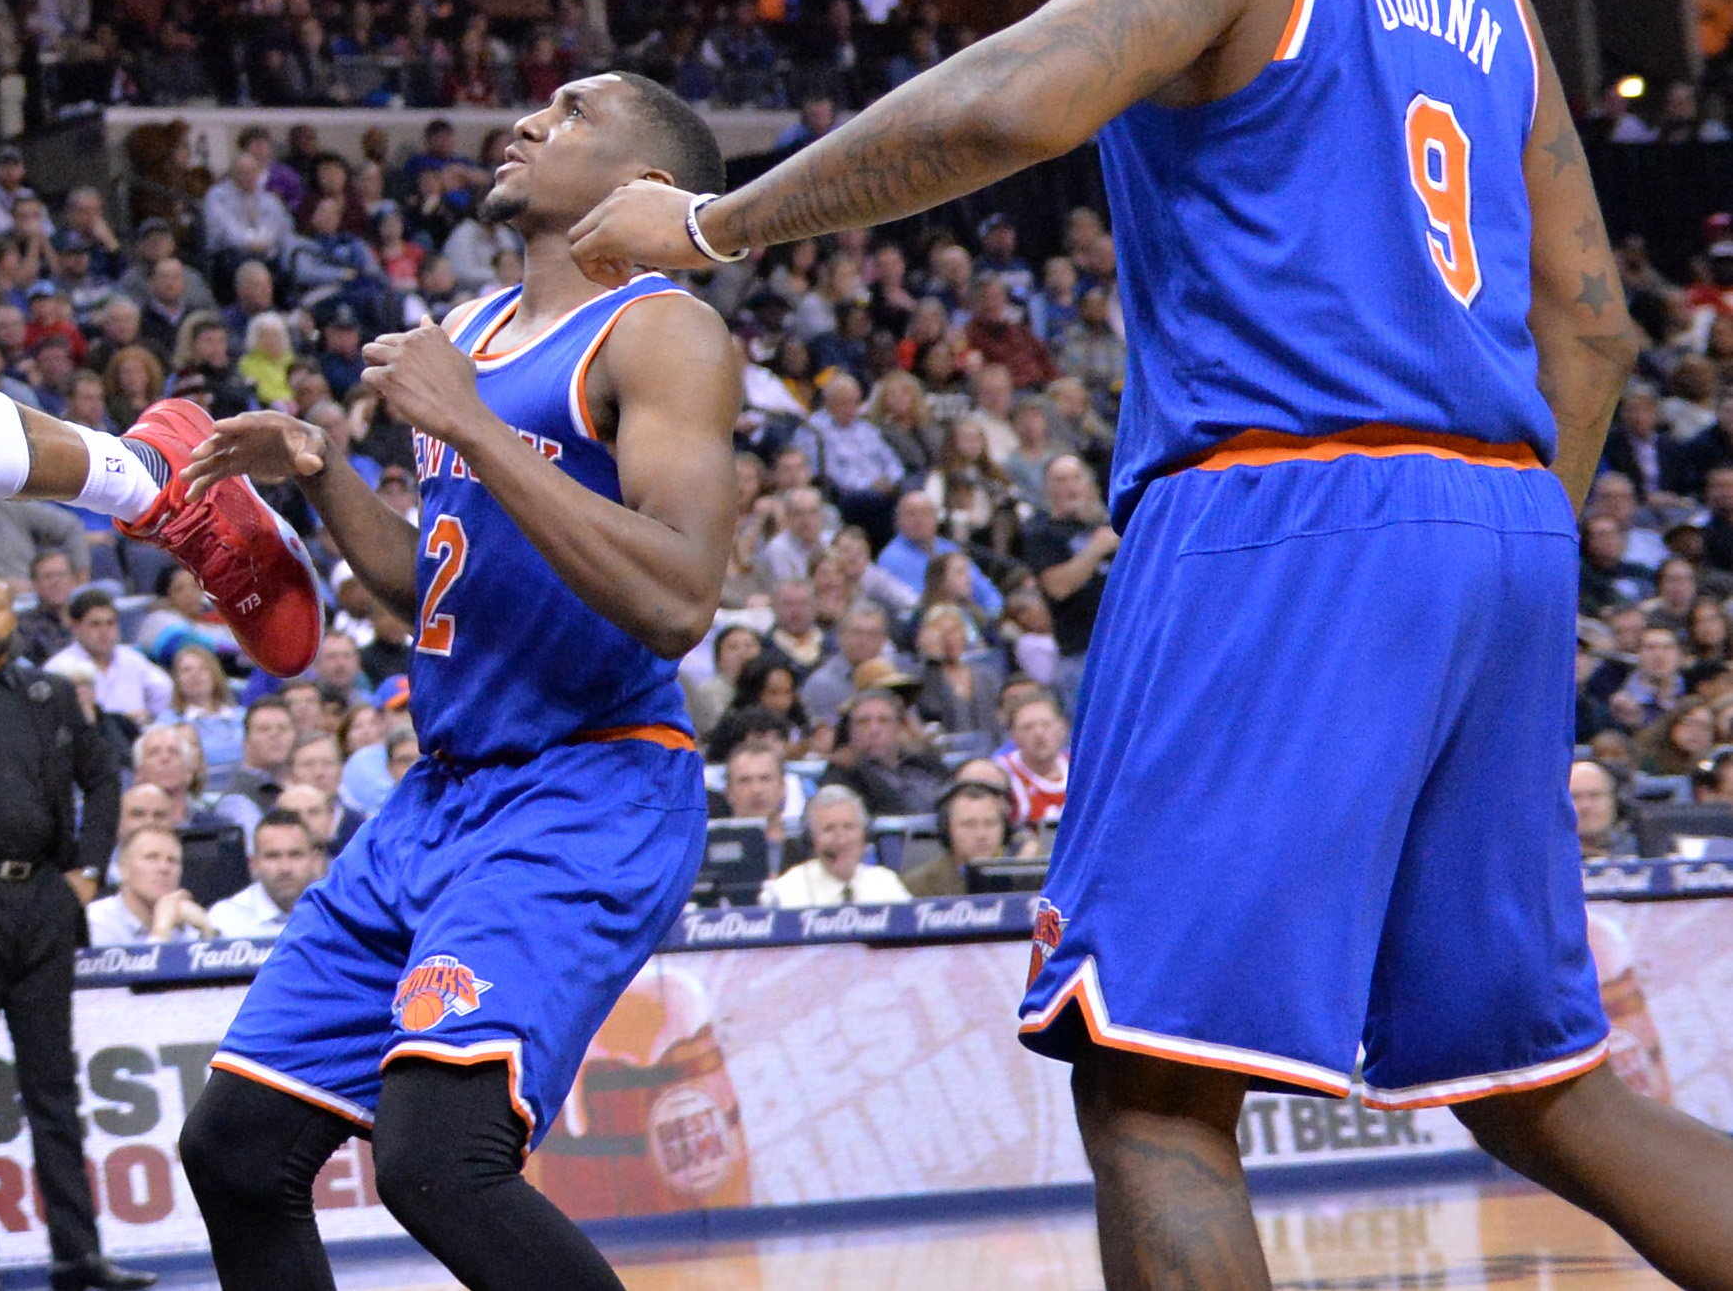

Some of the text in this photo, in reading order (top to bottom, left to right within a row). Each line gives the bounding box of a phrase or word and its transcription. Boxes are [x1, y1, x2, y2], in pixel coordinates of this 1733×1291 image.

[1405, 90, 1482, 310] 9
[416, 513, 469, 657] 2
[235, 592, 262, 615] 773
[683, 912, 775, 944] FanDuel
[800, 905, 891, 939] FanDuel
[915, 898, 1005, 934] FanDuel
[74, 944, 161, 977] anDuel
